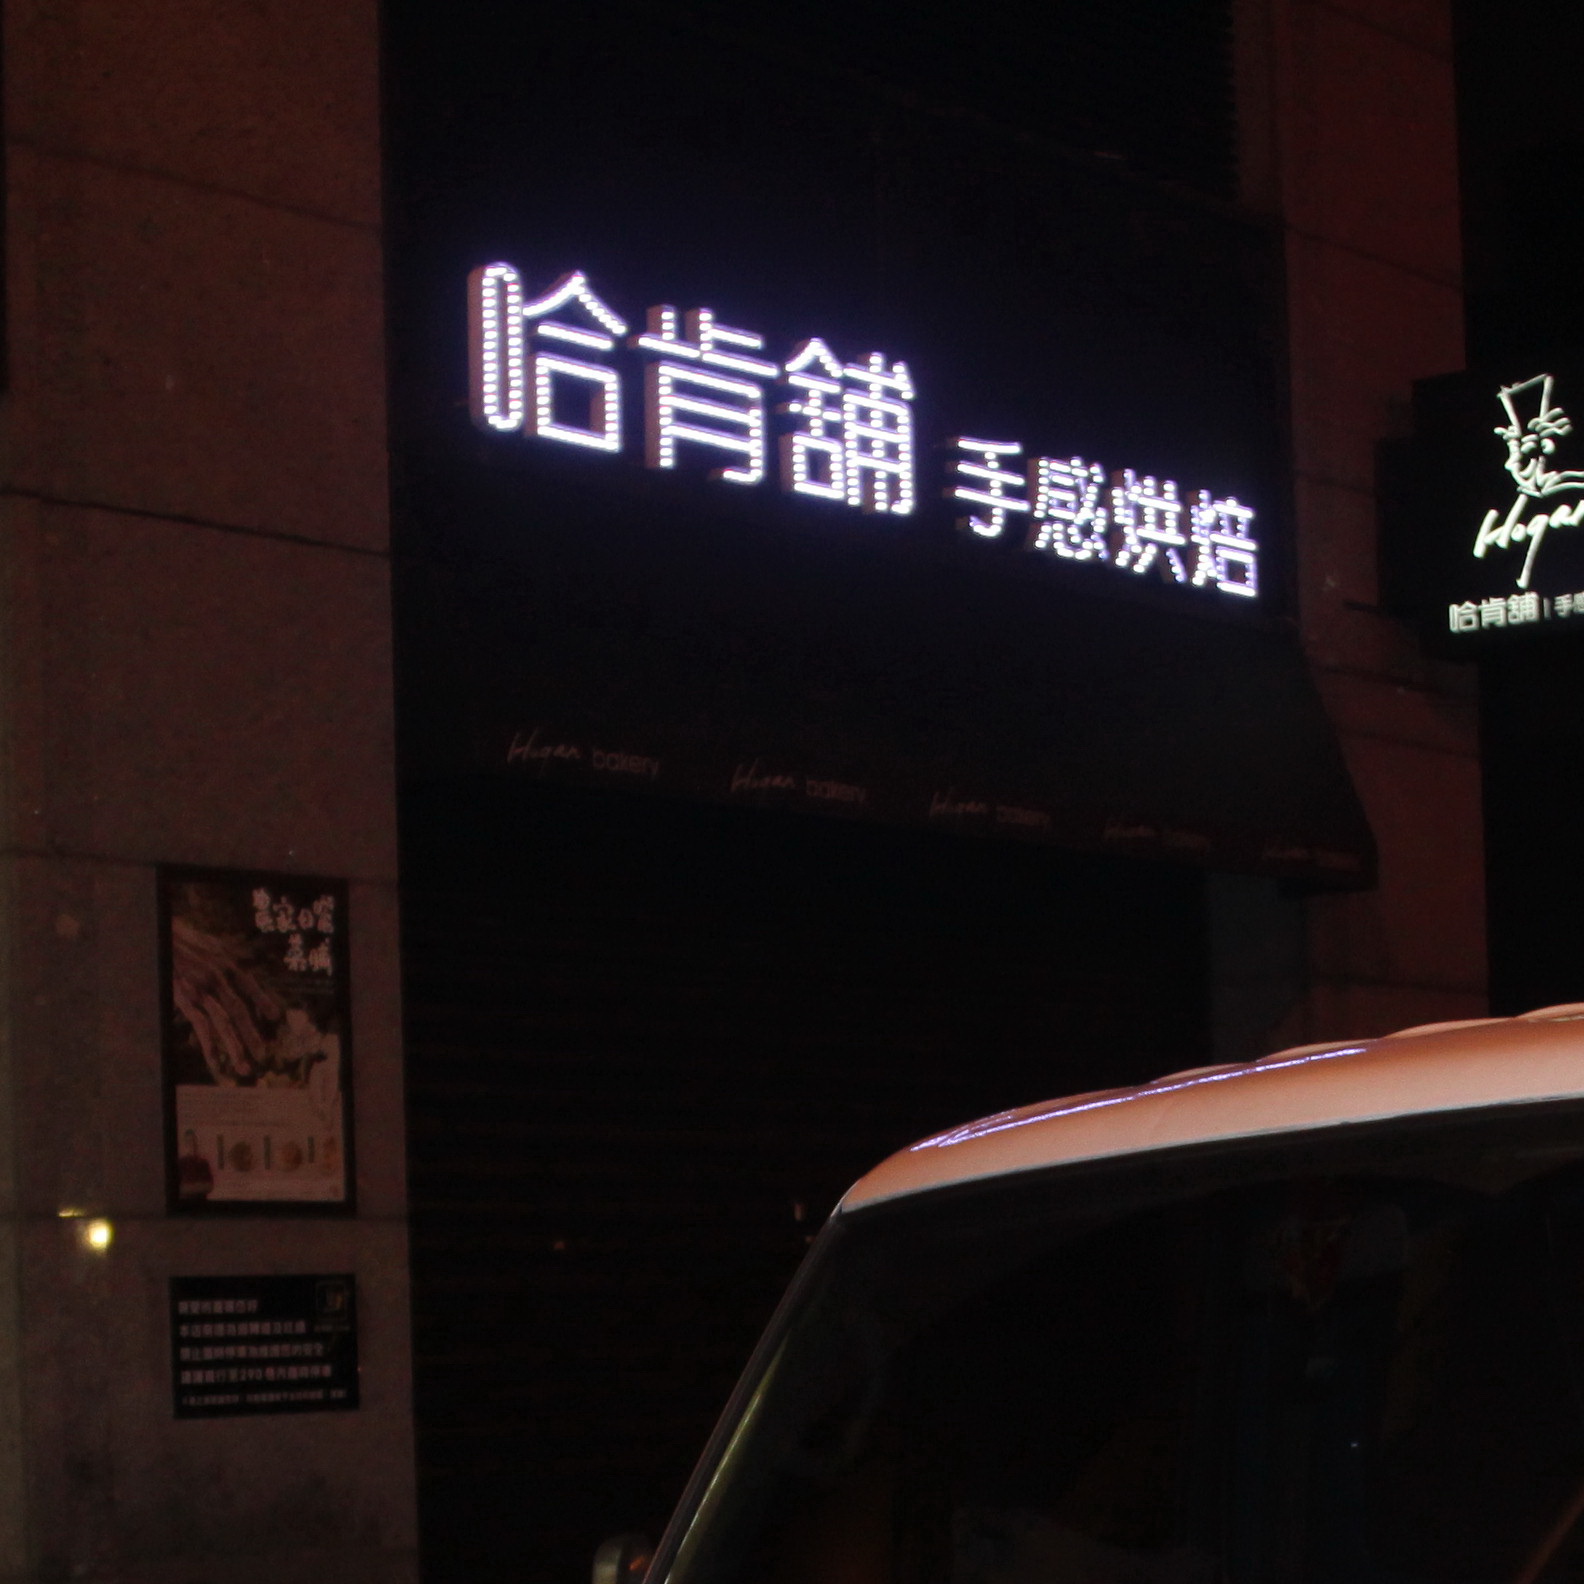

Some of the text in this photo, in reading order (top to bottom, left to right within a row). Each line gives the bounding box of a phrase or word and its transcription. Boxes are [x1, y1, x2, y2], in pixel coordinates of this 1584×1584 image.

[468, 260, 1258, 597] 哈肯舖 手感烘焙
